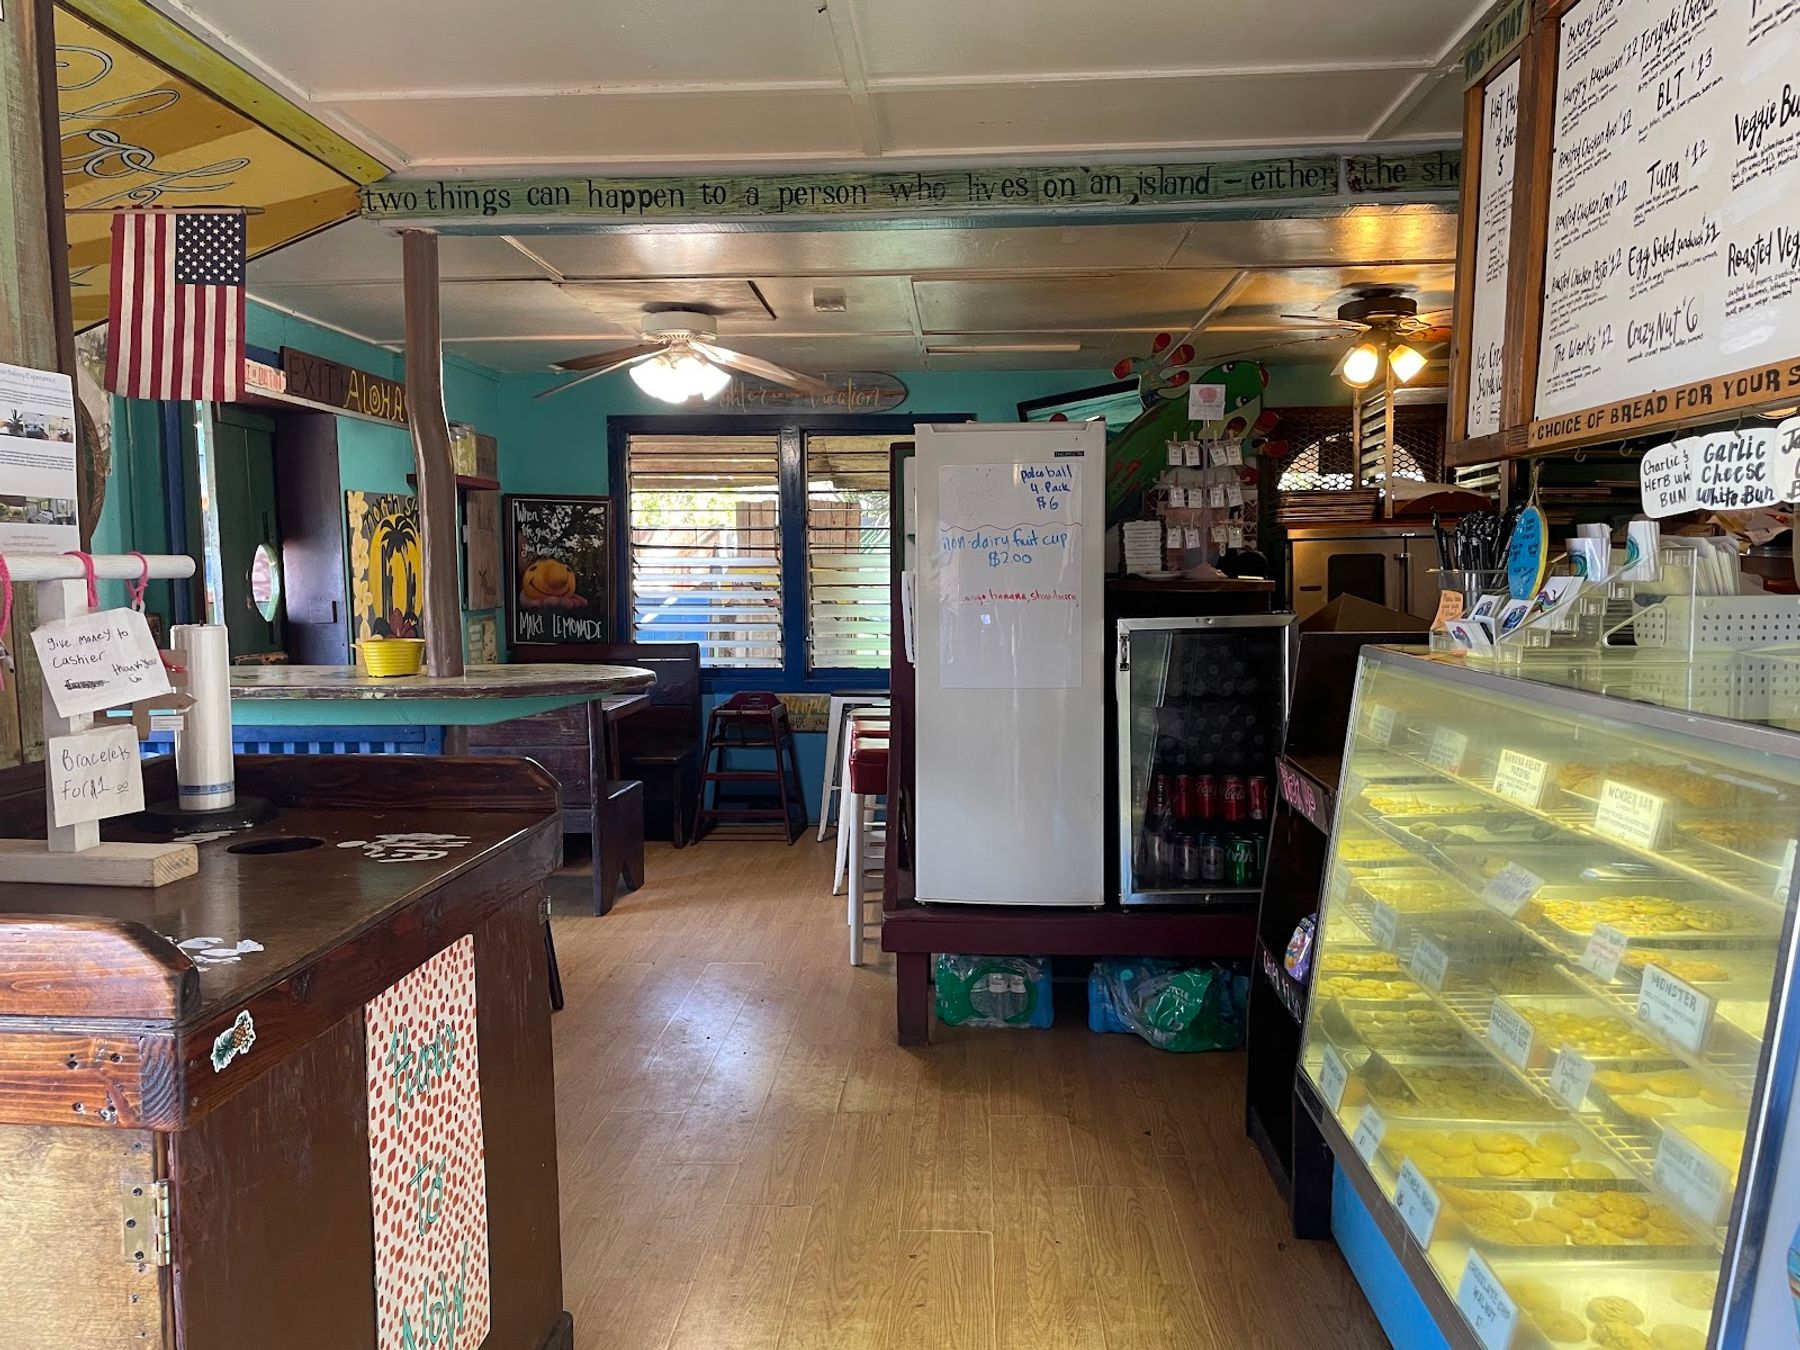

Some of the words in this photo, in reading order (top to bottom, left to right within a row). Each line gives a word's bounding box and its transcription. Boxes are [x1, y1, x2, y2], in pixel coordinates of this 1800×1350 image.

[1639, 4, 1680, 62] Teriyaki
[1657, 67, 1685, 112] BLT
[1734, 98, 1778, 151] Veggie
[1559, 138, 1581, 169] Roasted
[364, 189, 417, 212] two
[425, 181, 510, 217] things
[527, 185, 570, 206] can
[587, 179, 684, 215] happen
[702, 182, 727, 206] to
[746, 184, 759, 206] a
[777, 182, 867, 213] person
[889, 173, 946, 202] who
[968, 173, 1029, 201] lives
[1044, 176, 1076, 200] on
[1090, 172, 1121, 196] an
[1137, 165, 1212, 197] island
[1361, 153, 1407, 185] the
[1647, 159, 1679, 195] Tuna
[1555, 203, 1577, 232] Roasted
[1628, 245, 1650, 281] Egg
[1651, 227, 1677, 267] Salad
[1727, 231, 1773, 277] Roasted
[1551, 267, 1571, 294] Roasted
[1627, 319, 1655, 350] Crazy
[1655, 305, 1682, 343] Nut
[1552, 343, 1565, 374] The
[1568, 332, 1596, 360] Works
[289, 356, 336, 397] EXIT
[343, 369, 404, 422] ALOHA
[1537, 415, 1581, 441] CHOICE
[1587, 410, 1605, 429] OF
[1610, 394, 1667, 424] BREAD
[1675, 383, 1713, 410] FOR
[1723, 368, 1781, 400] YOUR
[1703, 435, 1767, 464] Garlic
[1046, 464, 1073, 478] ball
[1643, 455, 1680, 475] Garlic
[1701, 461, 1766, 485] Cheese
[1036, 496, 1059, 511] $6
[1696, 487, 1739, 507] White
[1742, 485, 1775, 506] Bun
[514, 501, 539, 523] When
[521, 543, 535, 557] you
[1042, 532, 1068, 548] cup
[78, 629, 112, 646] money
[117, 627, 129, 641] to
[519, 611, 545, 640] MAKE
[552, 612, 602, 640] LEMONADE
[62, 745, 131, 772] Bracelets
[62, 781, 88, 801] For
[1608, 785, 1638, 808] WONDER
[1651, 972, 1697, 1012] MONSTER
